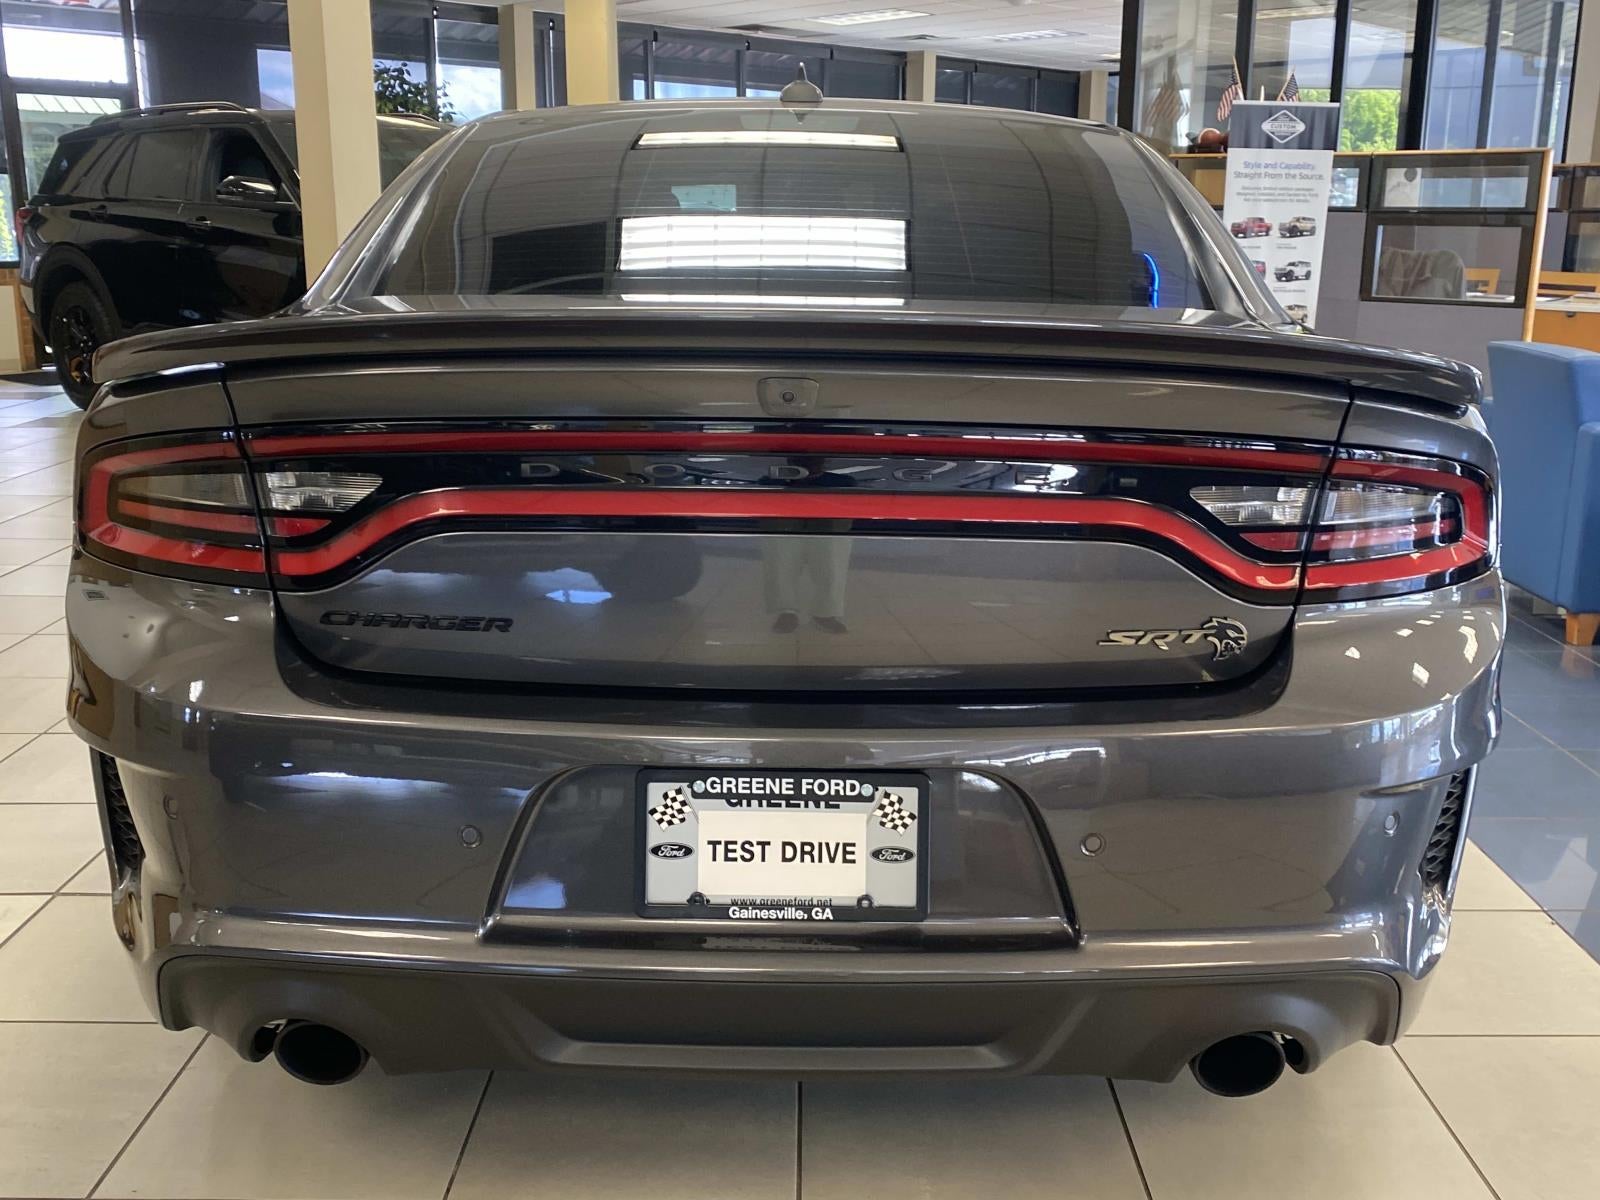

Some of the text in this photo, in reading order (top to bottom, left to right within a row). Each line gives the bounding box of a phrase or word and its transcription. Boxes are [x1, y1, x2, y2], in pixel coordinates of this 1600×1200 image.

[1243, 160, 1261, 170] Style
[1263, 161, 1278, 169] and
[1233, 170, 1262, 181] Straight
[1263, 171, 1283, 180] From
[1285, 171, 1297, 180] the
[520, 462, 1051, 487] DODGE
[319, 609, 514, 633] CHARGER
[1098, 629, 1217, 651] SRT
[705, 776, 861, 796] GREENE FORD
[657, 844, 686, 858] Ford
[707, 840, 857, 864] TEST DRIVE
[878, 848, 907, 861] Ford
[728, 906, 834, 920] Gainesville, GA
